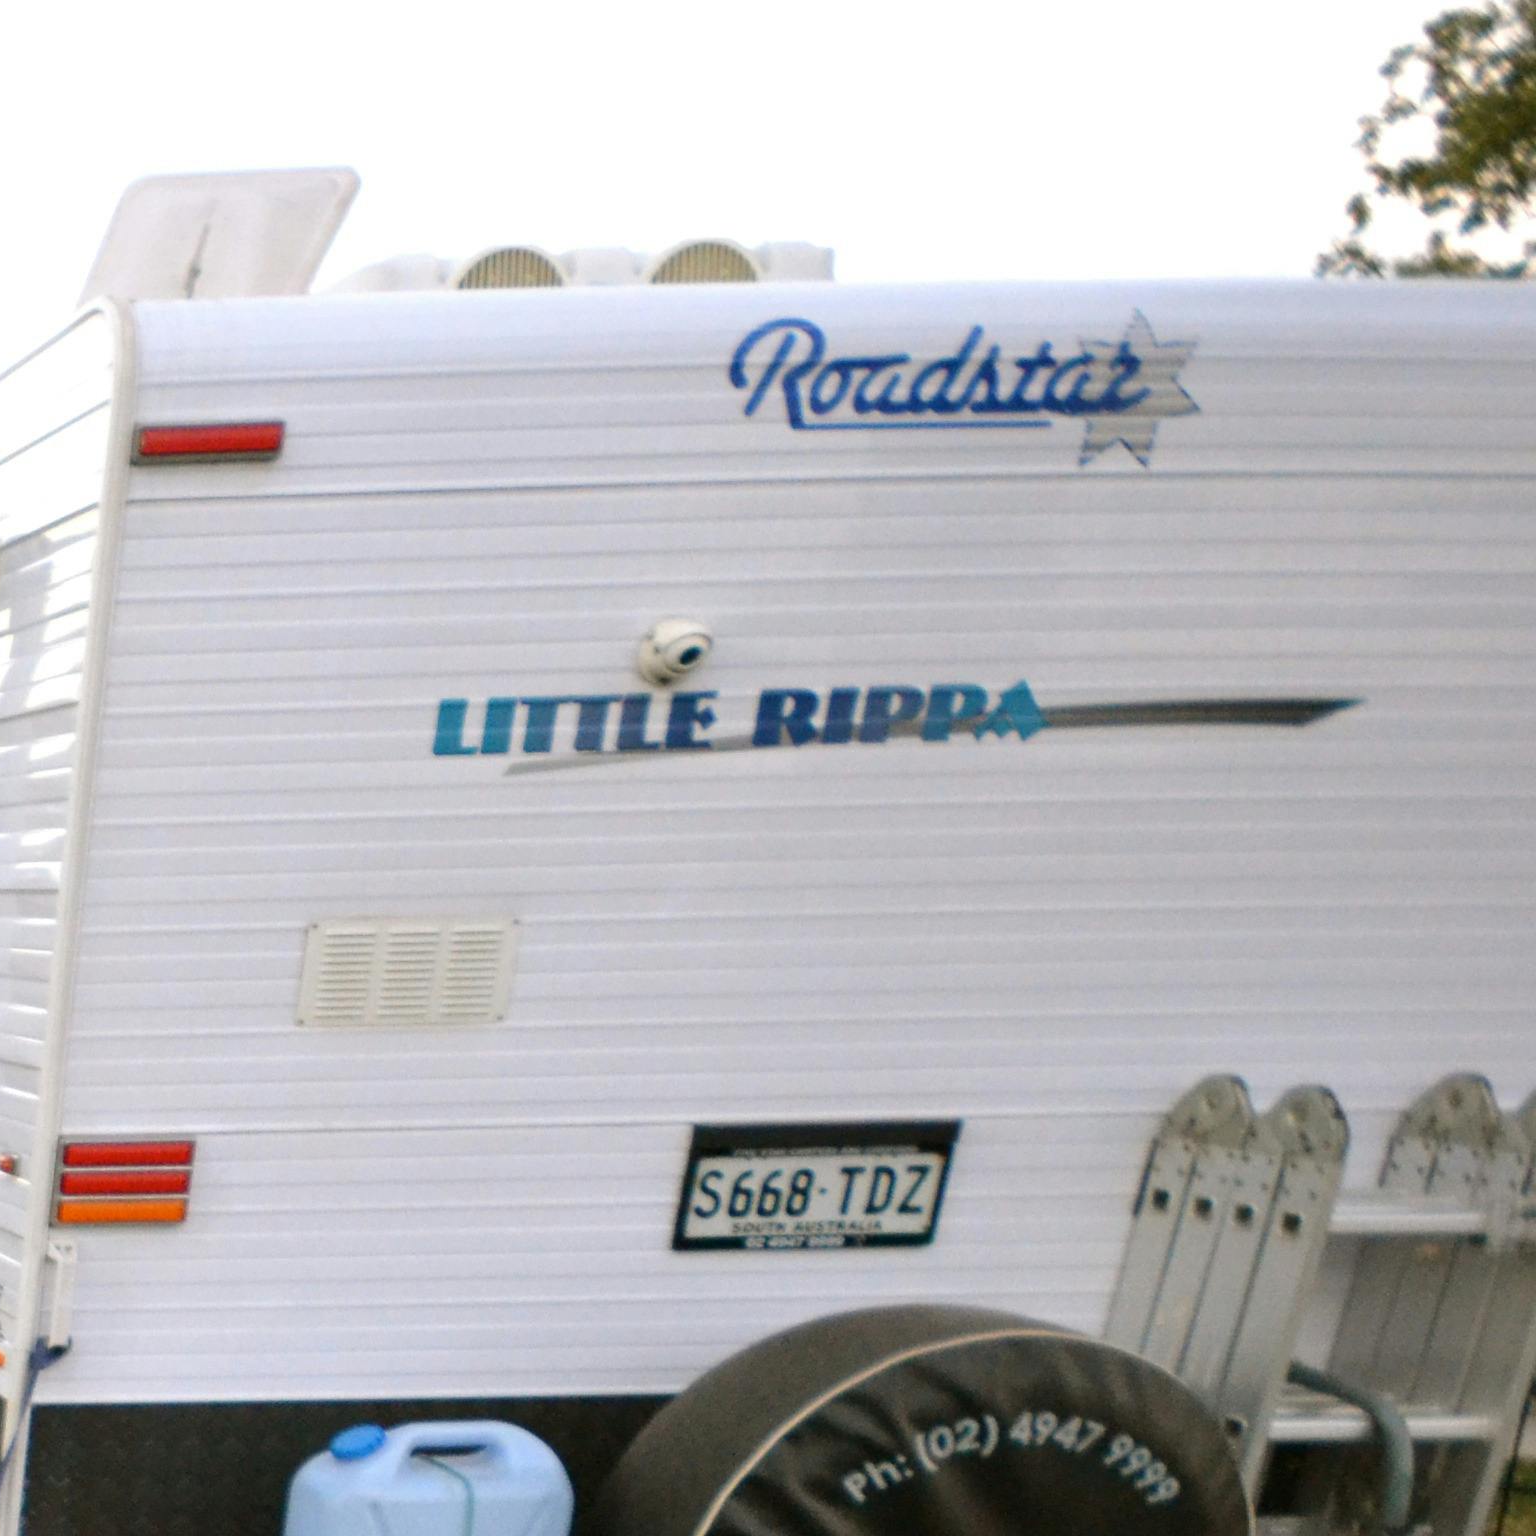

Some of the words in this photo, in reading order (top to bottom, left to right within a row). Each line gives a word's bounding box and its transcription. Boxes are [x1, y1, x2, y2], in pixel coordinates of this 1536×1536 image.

[729, 317, 1150, 430] Roadstar
[432, 690, 719, 755] LITTLE
[752, 679, 1051, 746] RIPPA
[732, 1221, 786, 1233] SOUTH
[794, 1219, 883, 1232] AUSTRALIA
[843, 1454, 914, 1503] Ph:
[914, 1414, 999, 1473] (02)
[1009, 1411, 1106, 1451] 4947
[1104, 1434, 1180, 1504] 9999
